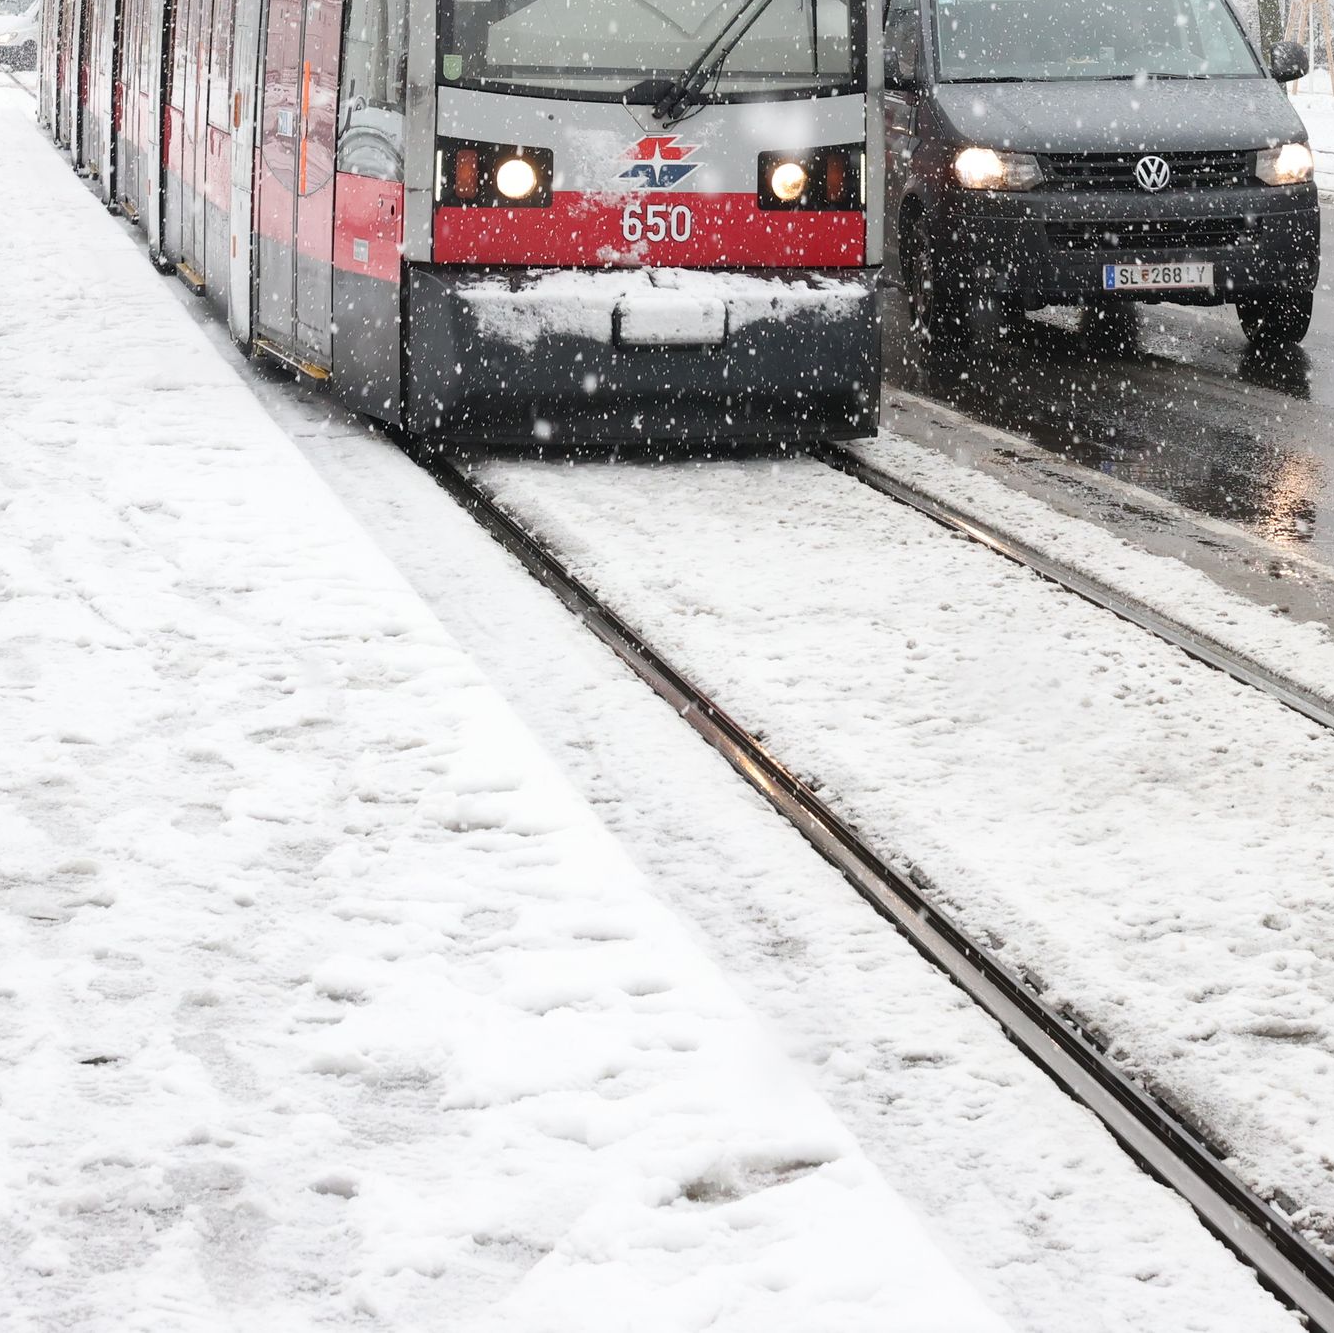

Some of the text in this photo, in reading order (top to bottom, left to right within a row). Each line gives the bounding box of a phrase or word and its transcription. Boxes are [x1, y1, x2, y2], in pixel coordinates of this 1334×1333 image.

[622, 204, 691, 242] 650
[1119, 268, 1138, 285] SL
[1151, 267, 1182, 284] 268
